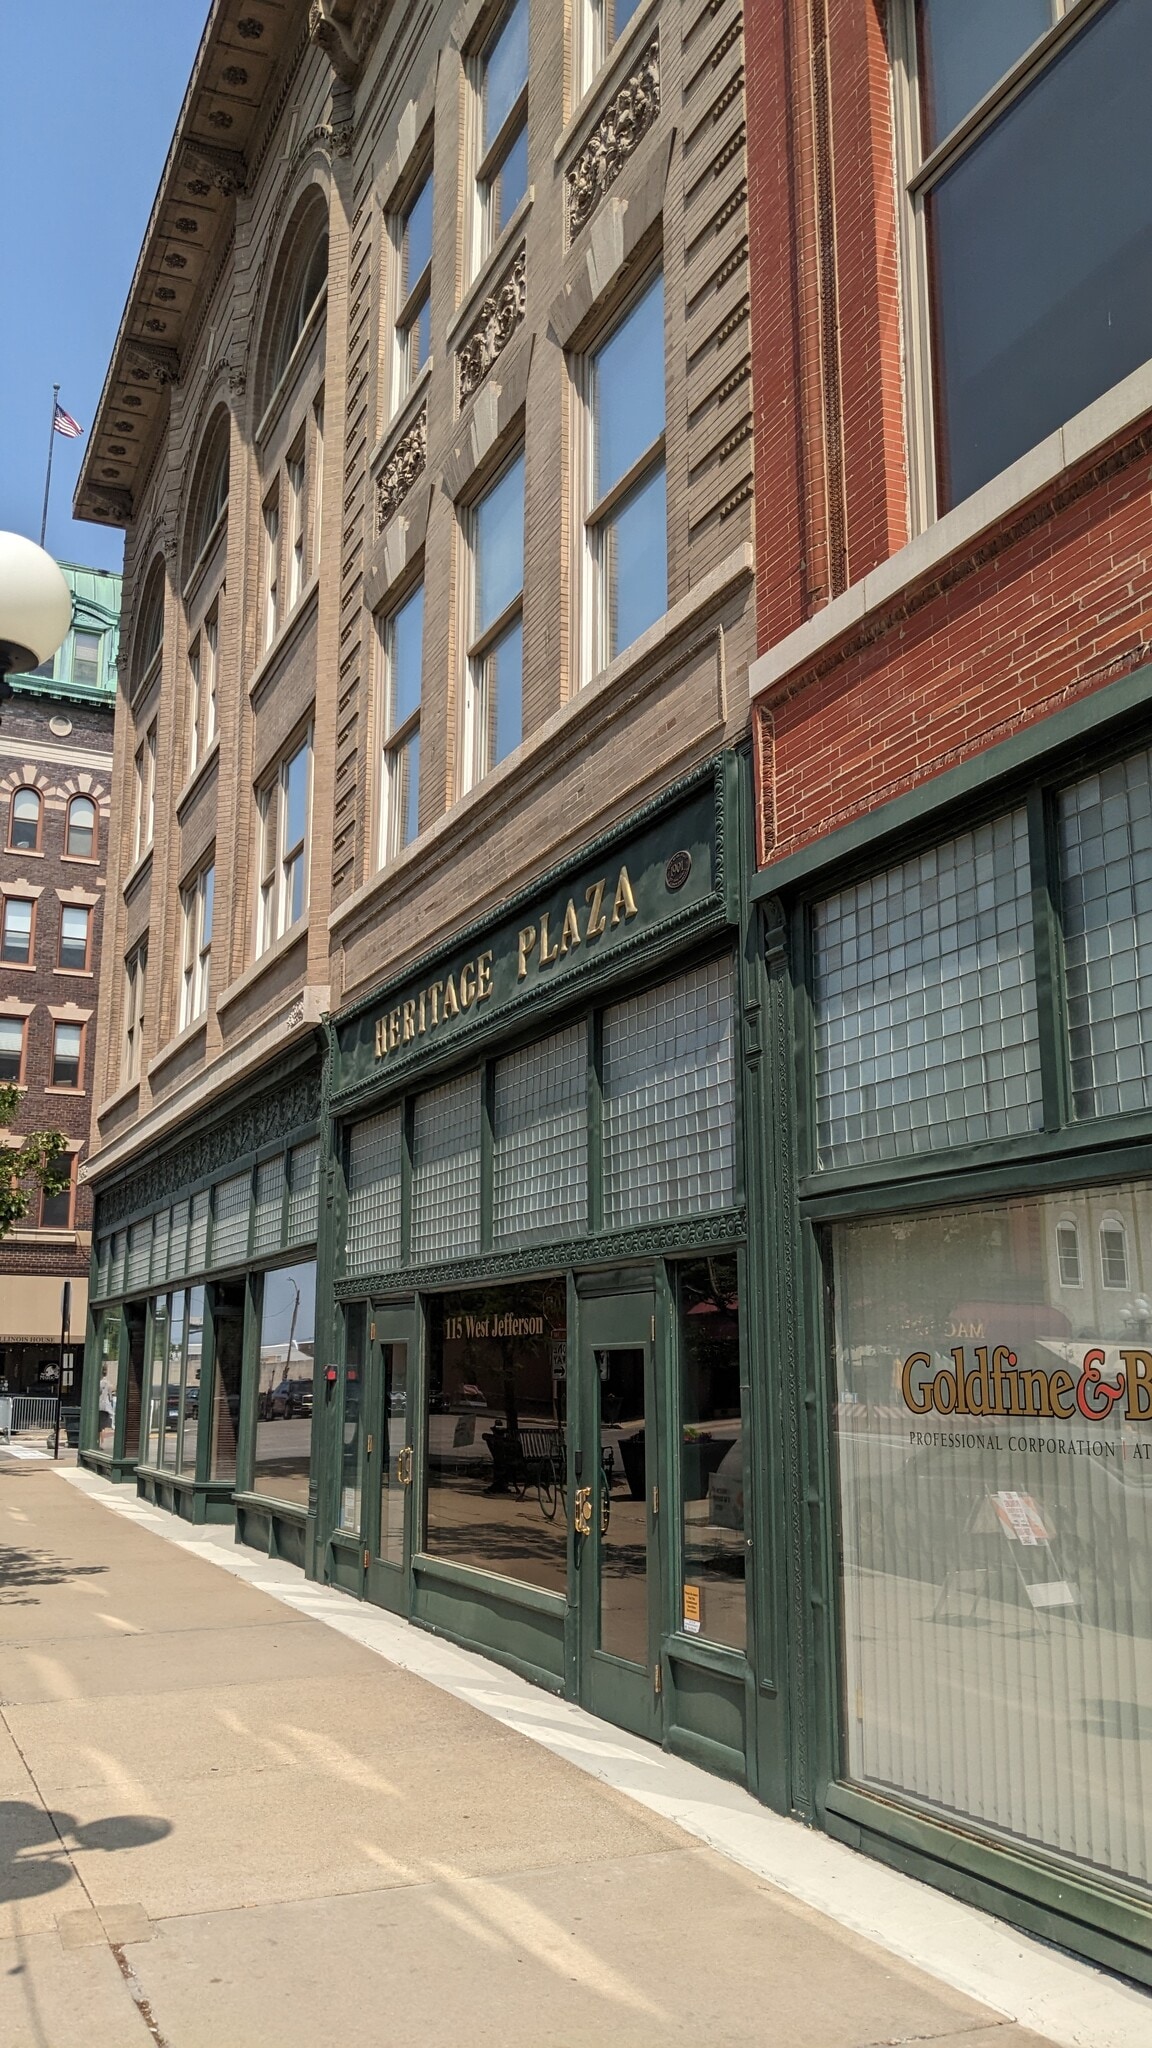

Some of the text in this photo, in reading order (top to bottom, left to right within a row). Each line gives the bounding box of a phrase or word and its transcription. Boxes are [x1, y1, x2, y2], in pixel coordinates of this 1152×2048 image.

[374, 865, 638, 1060] HERITAGE PLAZA
[446, 1312, 544, 1340] 115 West Jefferson
[901, 1345, 1076, 1420] Goldfine
[908, 1431, 1003, 1451] PROFESSIONAL
[1007, 1436, 1116, 1457] CORPORATION
